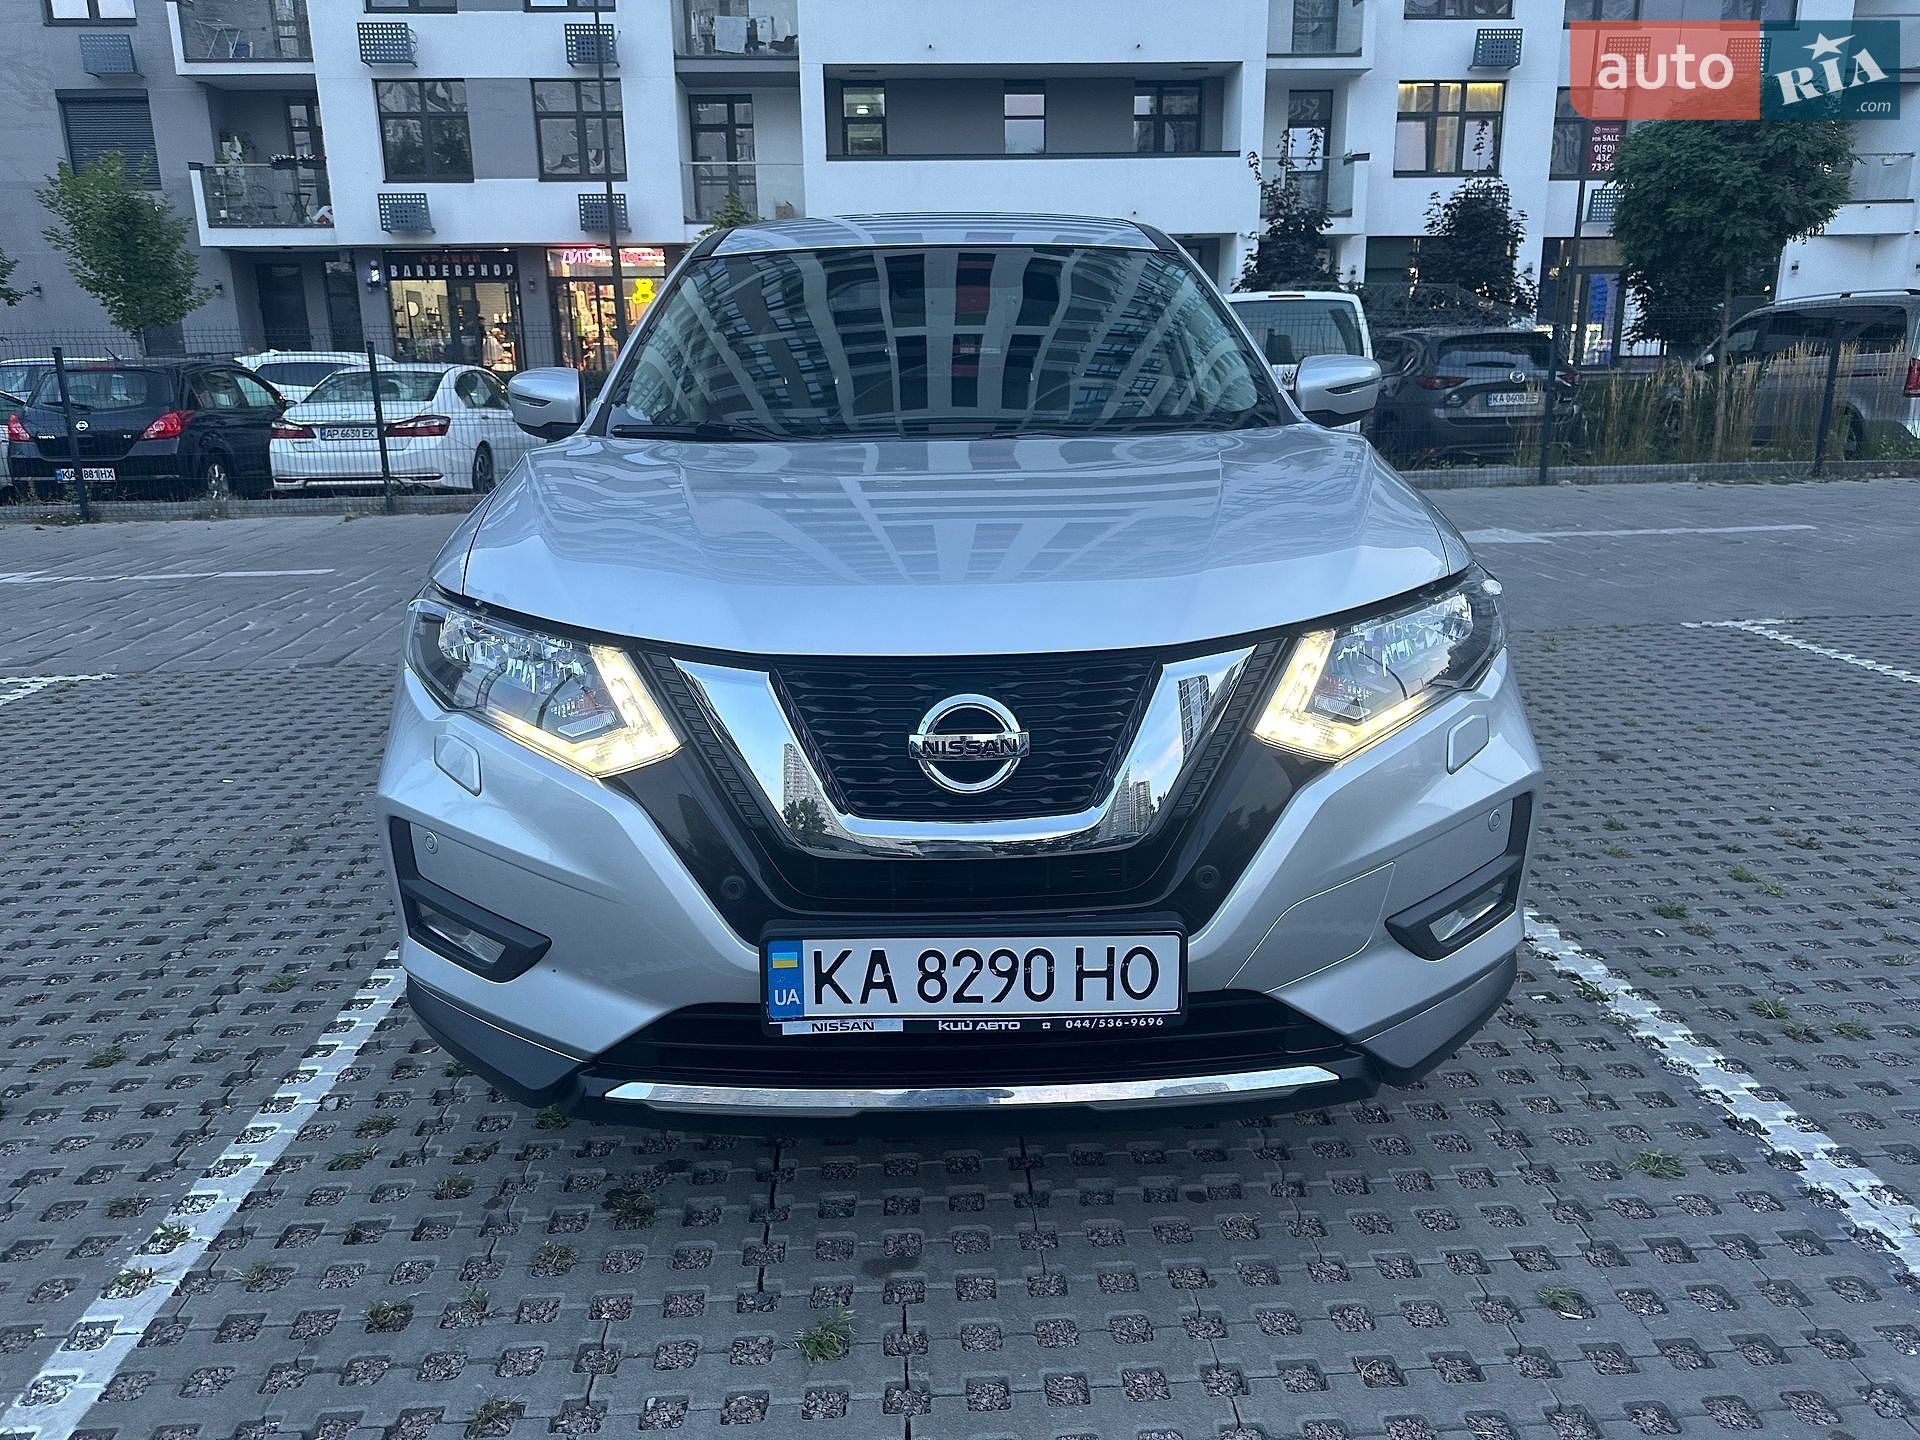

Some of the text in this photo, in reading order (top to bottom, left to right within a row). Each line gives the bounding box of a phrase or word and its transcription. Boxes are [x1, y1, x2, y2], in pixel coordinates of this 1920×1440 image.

[390, 264, 514, 277] BARBERSHOP
[326, 429, 374, 438] AP 6630 EK
[921, 738, 1018, 755] NISSAN
[813, 945, 1160, 1005] KA 8290 HO
[774, 989, 801, 1006] UA
[811, 1021, 876, 1033] NISSAN
[1065, 1016, 1164, 1030] 044/536-9696
